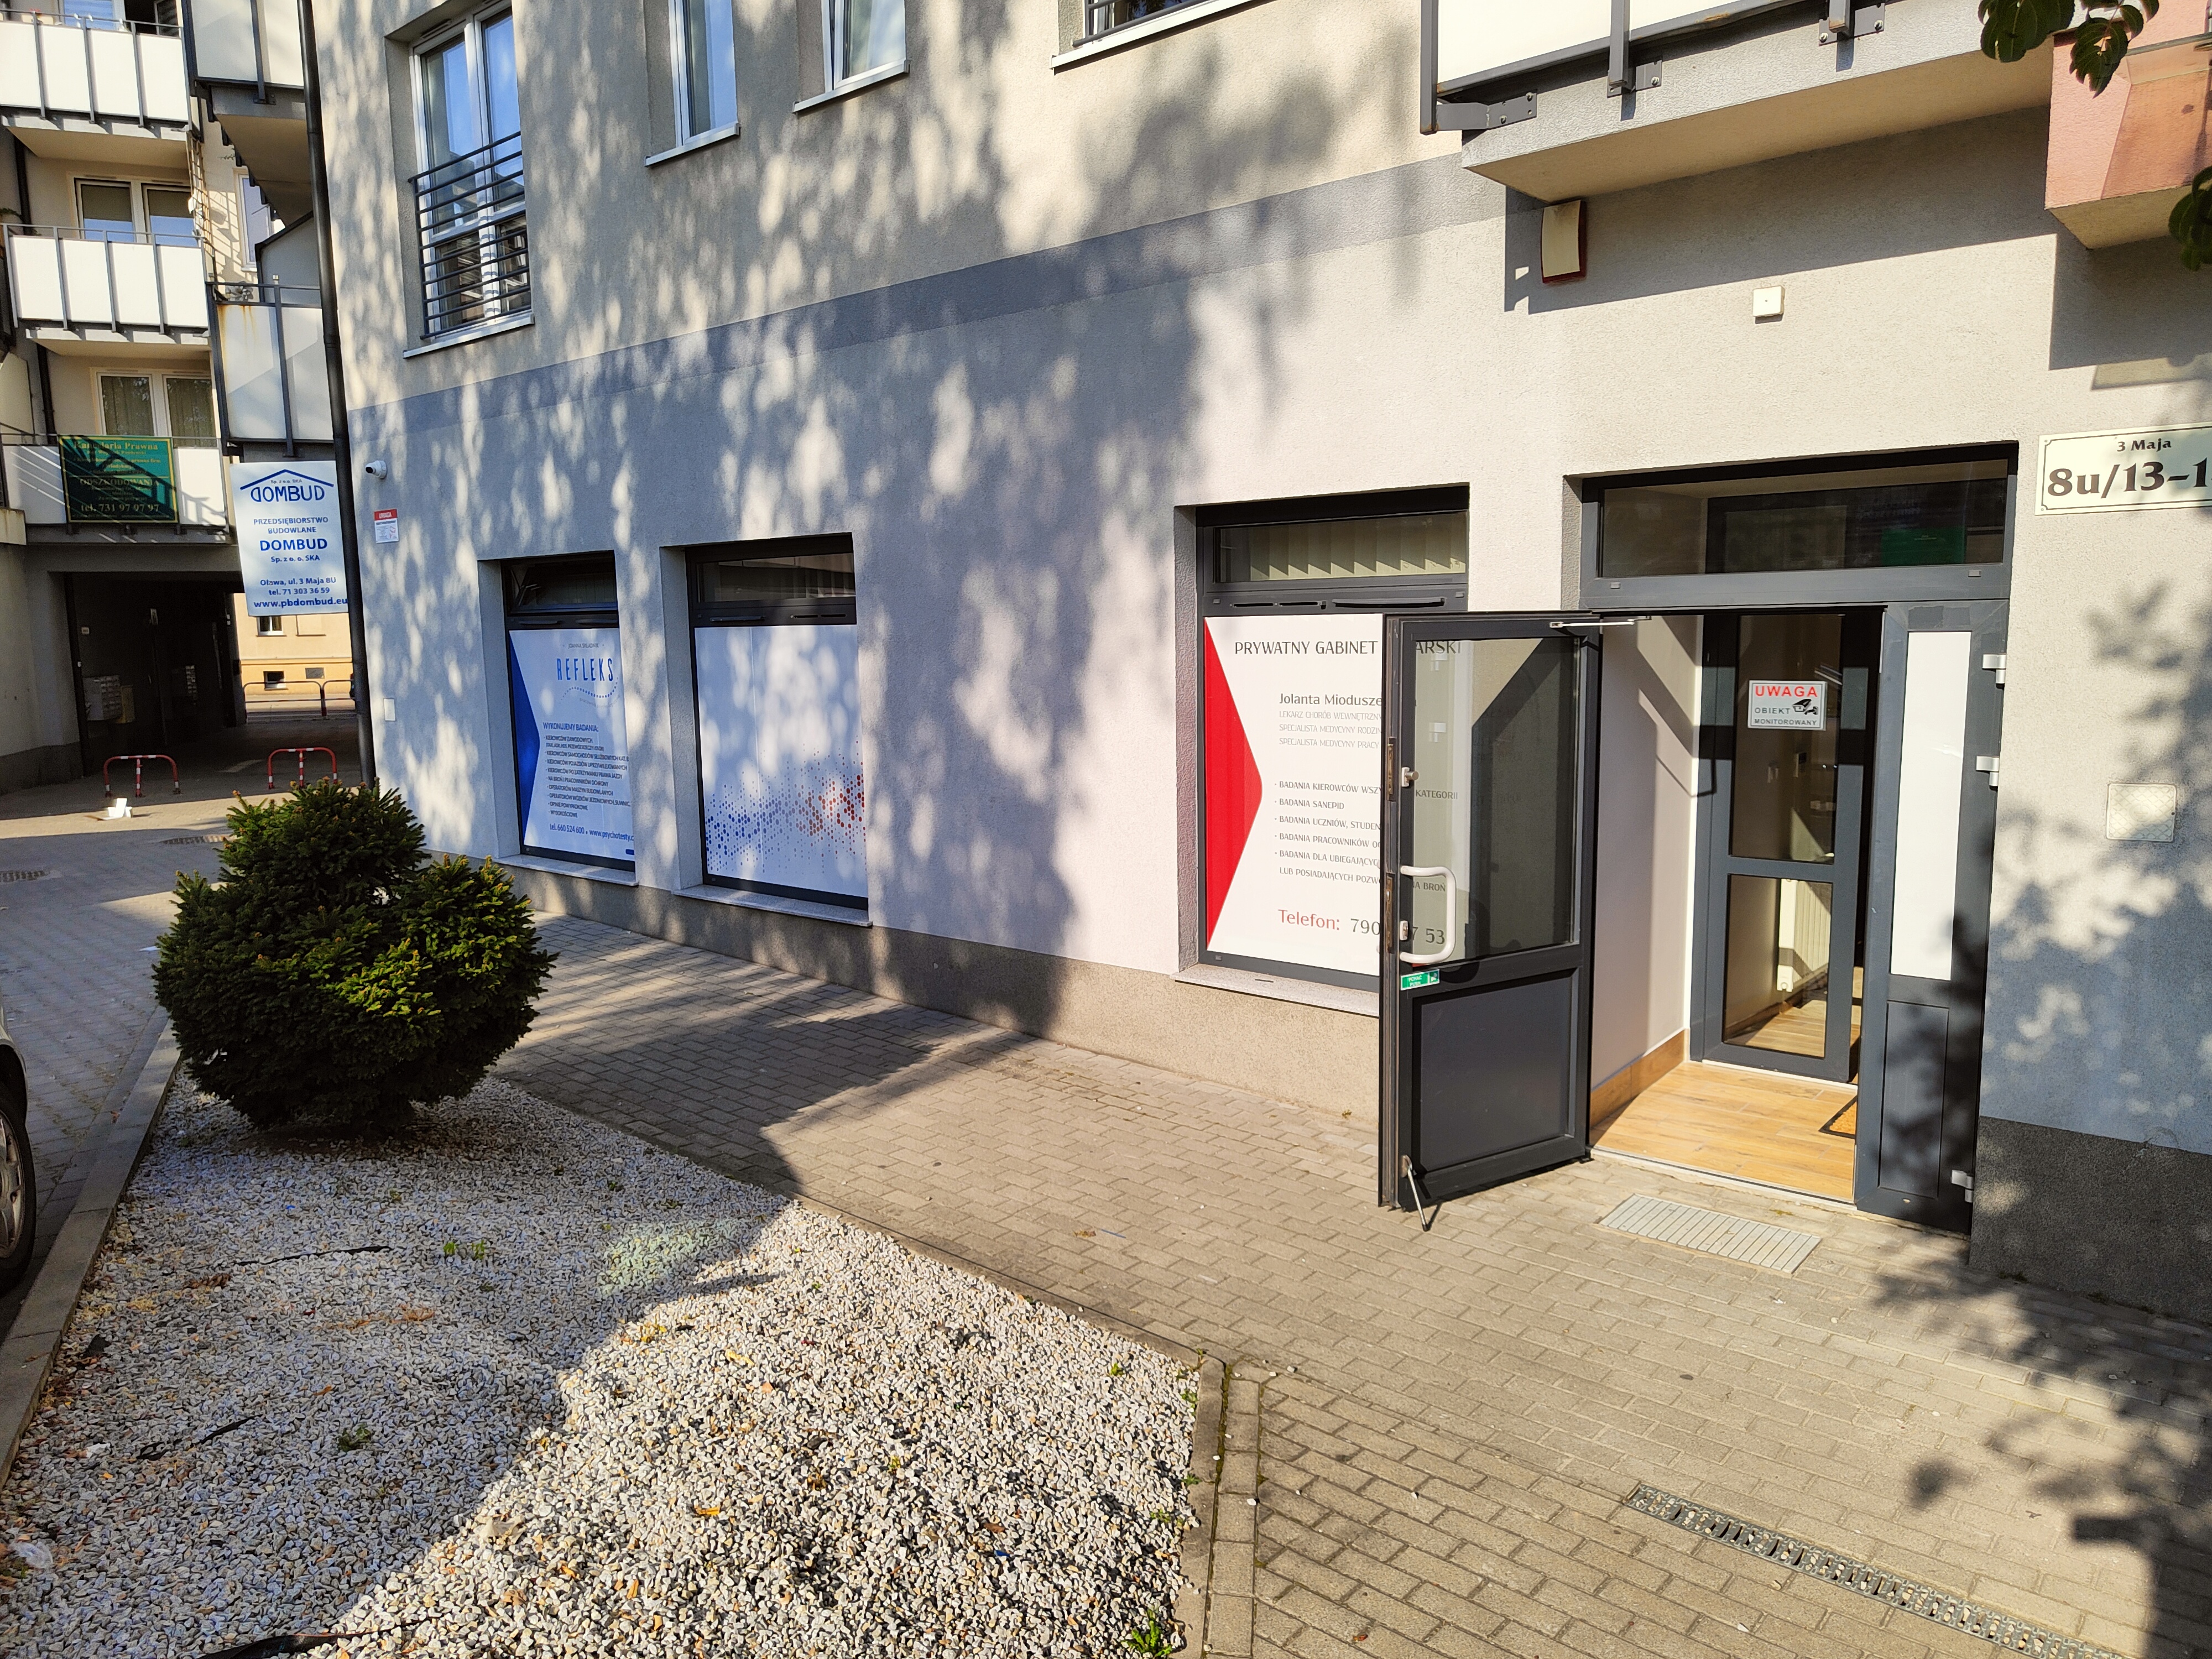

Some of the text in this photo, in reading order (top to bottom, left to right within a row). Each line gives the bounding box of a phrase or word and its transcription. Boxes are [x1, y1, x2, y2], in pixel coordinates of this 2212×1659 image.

[2116, 438, 2172, 452] 3 Maja
[2047, 457, 2212, 498] 8u/13-1
[251, 485, 325, 502] DOMBUD
[253, 517, 328, 525] PRZEDSIĘBIORSTWO
[259, 538, 328, 551] DOMBUD
[306, 577, 324, 586] Maja
[253, 597, 348, 608] www.pbdombud.eu
[1235, 641, 1461, 655] PRYWATNY GABINET ARSKI
[556, 658, 613, 681] REFLEKS
[1755, 686, 1818, 697] UWAGA
[1279, 693, 1382, 706] Jolanta Miodusze
[1305, 709, 1331, 719] CHORÓB
[542, 722, 599, 732] WYKONUJEMY BADANIA:
[1279, 724, 1318, 732] SPECJALISTA
[1319, 726, 1355, 734] MEDYCYNY
[1279, 738, 1318, 746] SPECJALISTA
[1319, 739, 1355, 748] MEDYCYNY
[1279, 781, 1310, 790] BADANIA
[1313, 782, 1359, 793] KIEROWCÓW
[1416, 790, 1458, 800] KATEGORII
[1279, 799, 1344, 810] BADANIA SANEPID
[1279, 816, 1381, 830] BADANIA UCZNIÓW, STUDEN
[1280, 833, 1311, 842] BADANIA
[1313, 836, 1370, 848] PRACOWNIKÓW
[1280, 850, 1380, 867] BADANIA DLA UBIEGAJĄCYC
[1296, 869, 1353, 881] POSIADAJĄCYCH
[1423, 881, 1446, 892] BROŃ
[1278, 909, 1340, 931] Telefon:
[1350, 918, 1380, 936] 790
